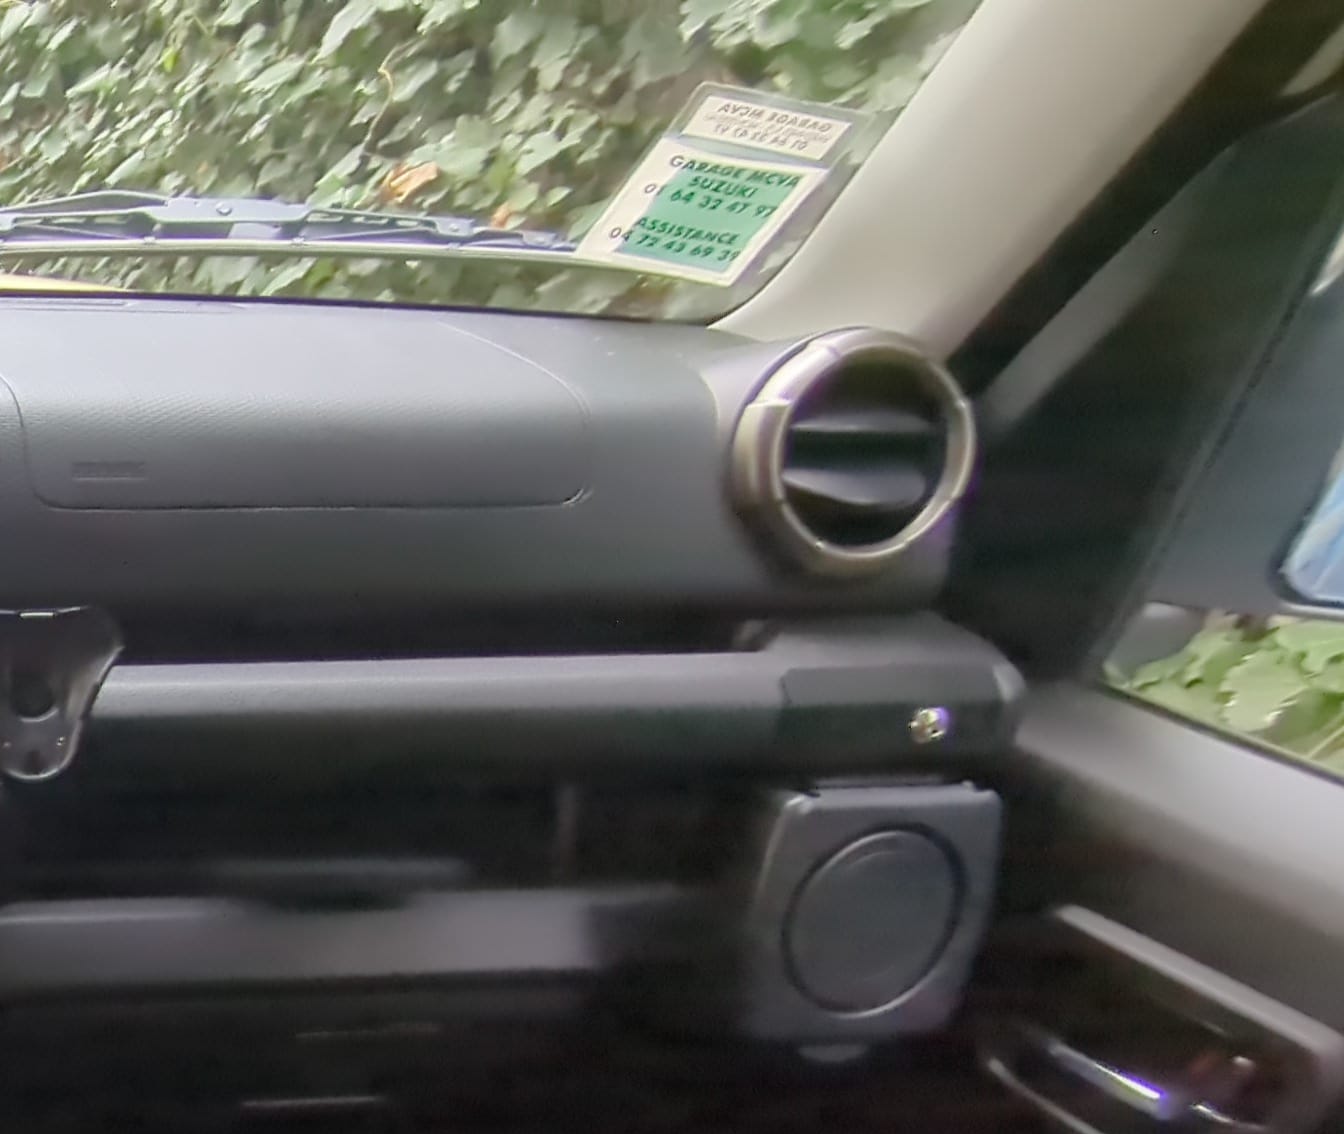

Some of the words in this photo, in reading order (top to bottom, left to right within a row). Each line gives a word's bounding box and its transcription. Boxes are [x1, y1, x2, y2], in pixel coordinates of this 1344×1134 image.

[670, 155, 746, 179] GARAGE
[747, 170, 803, 188] MCVA
[644, 183, 668, 196] 01
[670, 189, 695, 203] 64
[688, 175, 758, 199] SUZUKI
[608, 227, 635, 241] 04
[689, 246, 715, 258] 69
[634, 216, 741, 245] ASSISTANCE
